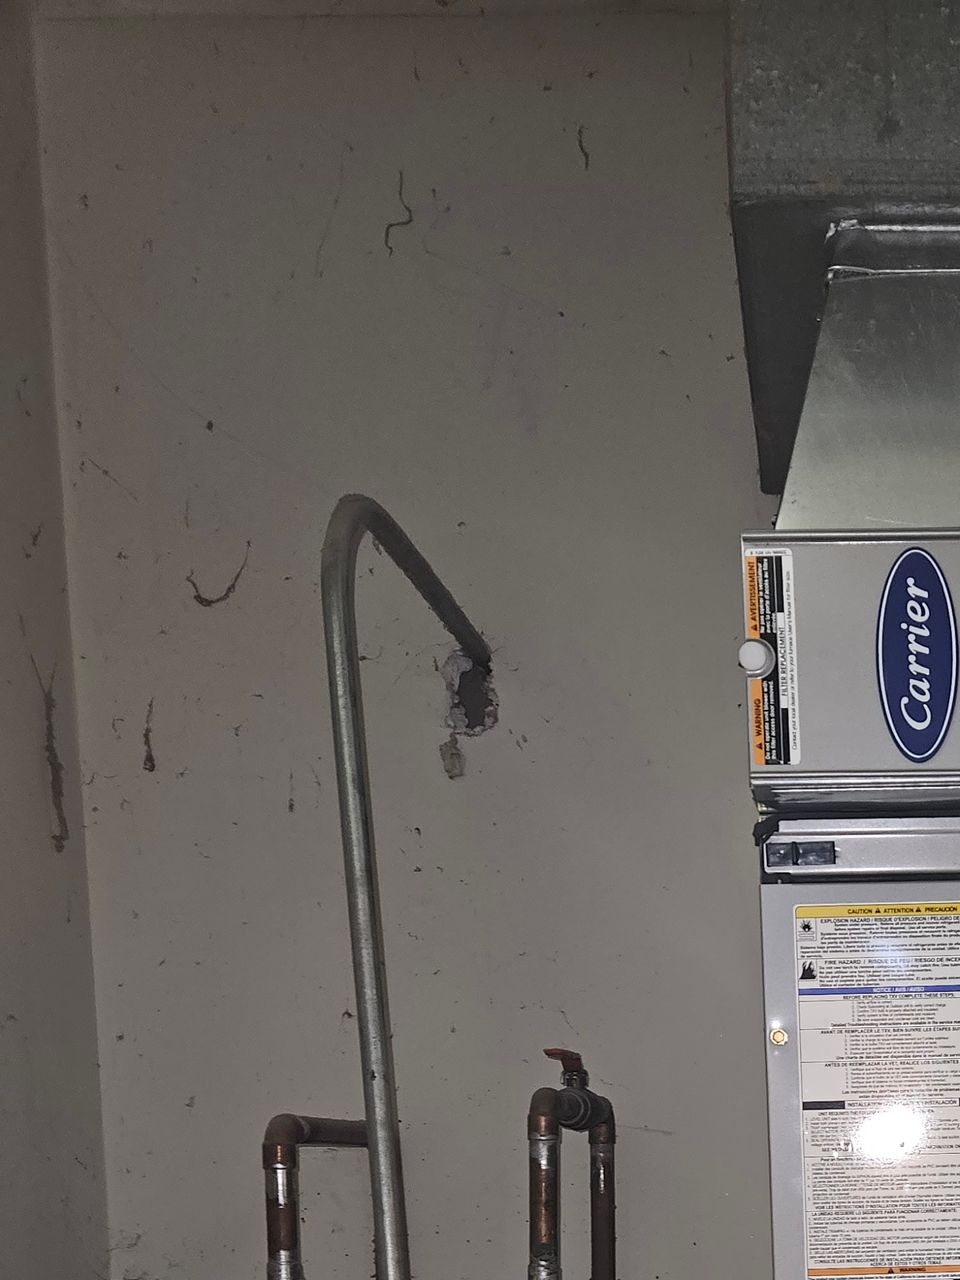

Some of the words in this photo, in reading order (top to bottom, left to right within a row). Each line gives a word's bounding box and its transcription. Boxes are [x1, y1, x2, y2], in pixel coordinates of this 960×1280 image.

[747, 561, 757, 621] AVERTISSEMENT
[779, 627, 787, 673] REPLACEMENT
[900, 576, 932, 731] Carrier
[754, 698, 762, 736] WARNING
